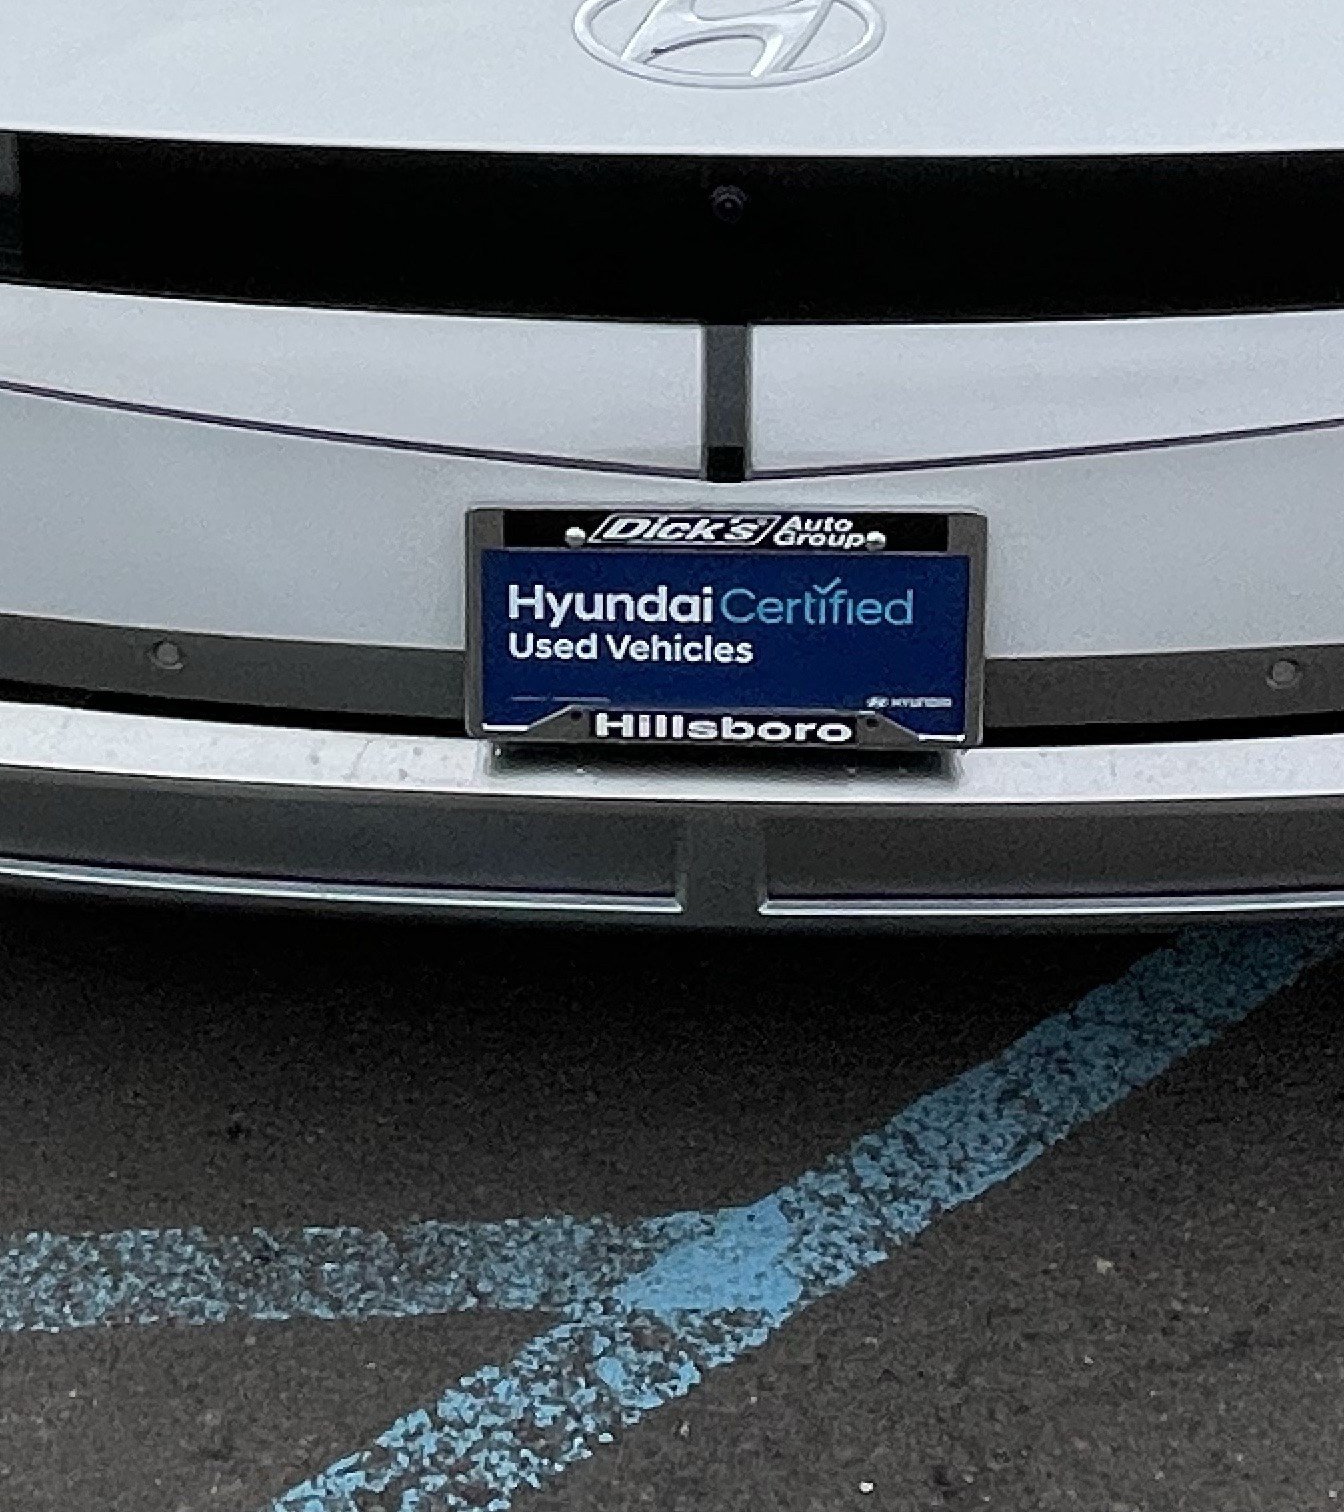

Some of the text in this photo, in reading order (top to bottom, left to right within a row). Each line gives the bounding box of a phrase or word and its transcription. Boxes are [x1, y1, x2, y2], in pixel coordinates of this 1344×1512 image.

[775, 515, 854, 533] Auto
[772, 531, 866, 550] Group
[508, 578, 914, 628] Hyundai Certified
[508, 631, 754, 664] Used Vehicles
[593, 712, 853, 743] Hillsboro
